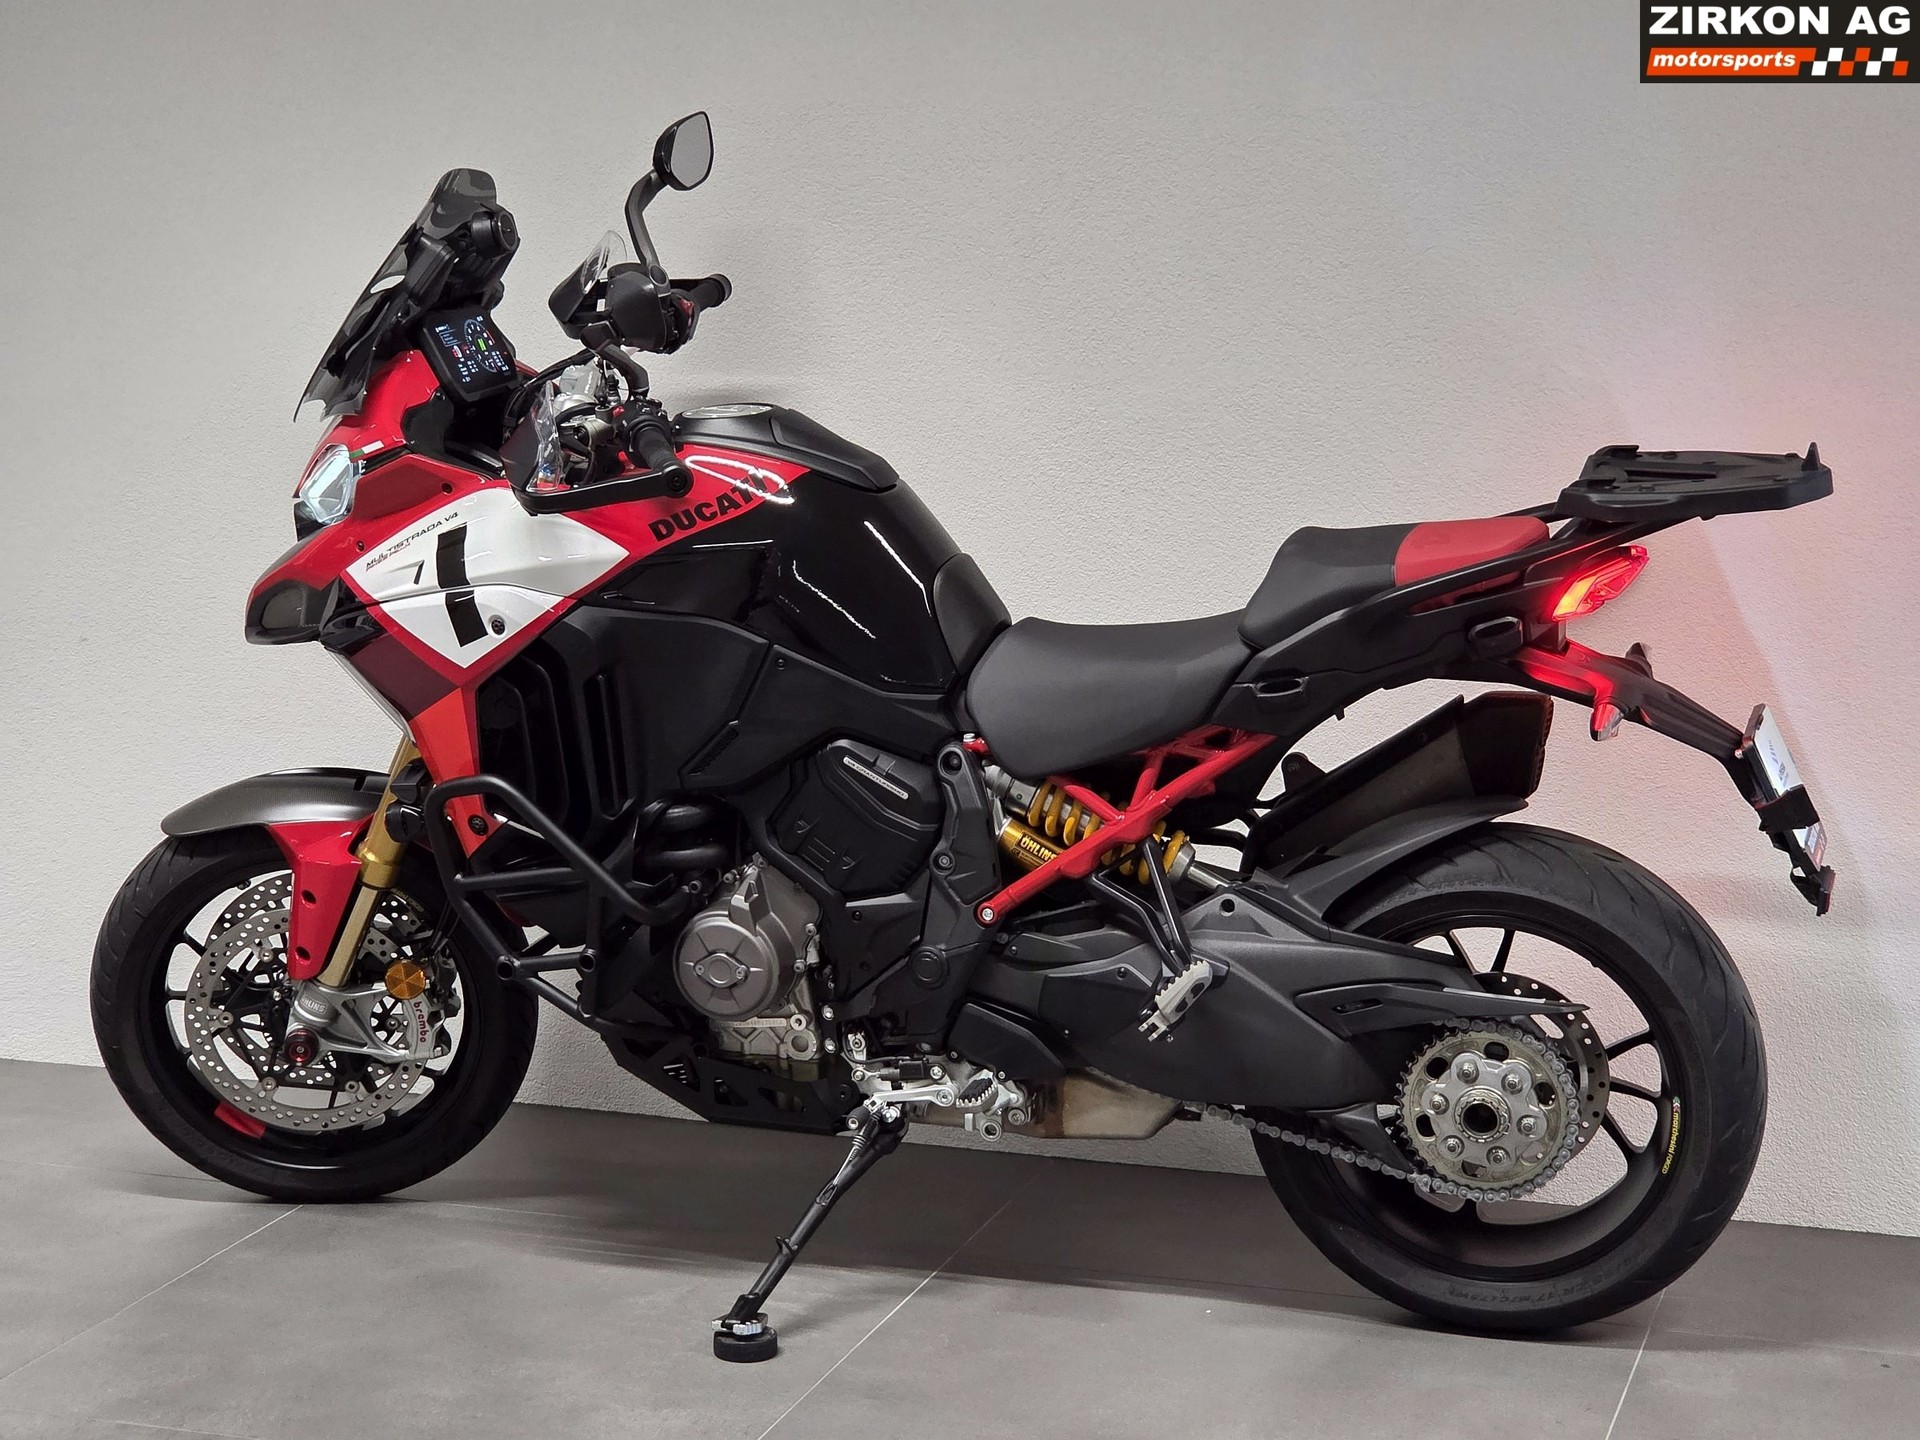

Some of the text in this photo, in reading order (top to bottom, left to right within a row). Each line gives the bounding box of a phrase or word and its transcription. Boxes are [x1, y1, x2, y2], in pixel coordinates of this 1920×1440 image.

[648, 470, 769, 542] DUCATI
[366, 511, 459, 568] MULTISTRADA V4
[413, 1001, 430, 1043] brembo
[1669, 1112, 1679, 1154] marchesini
